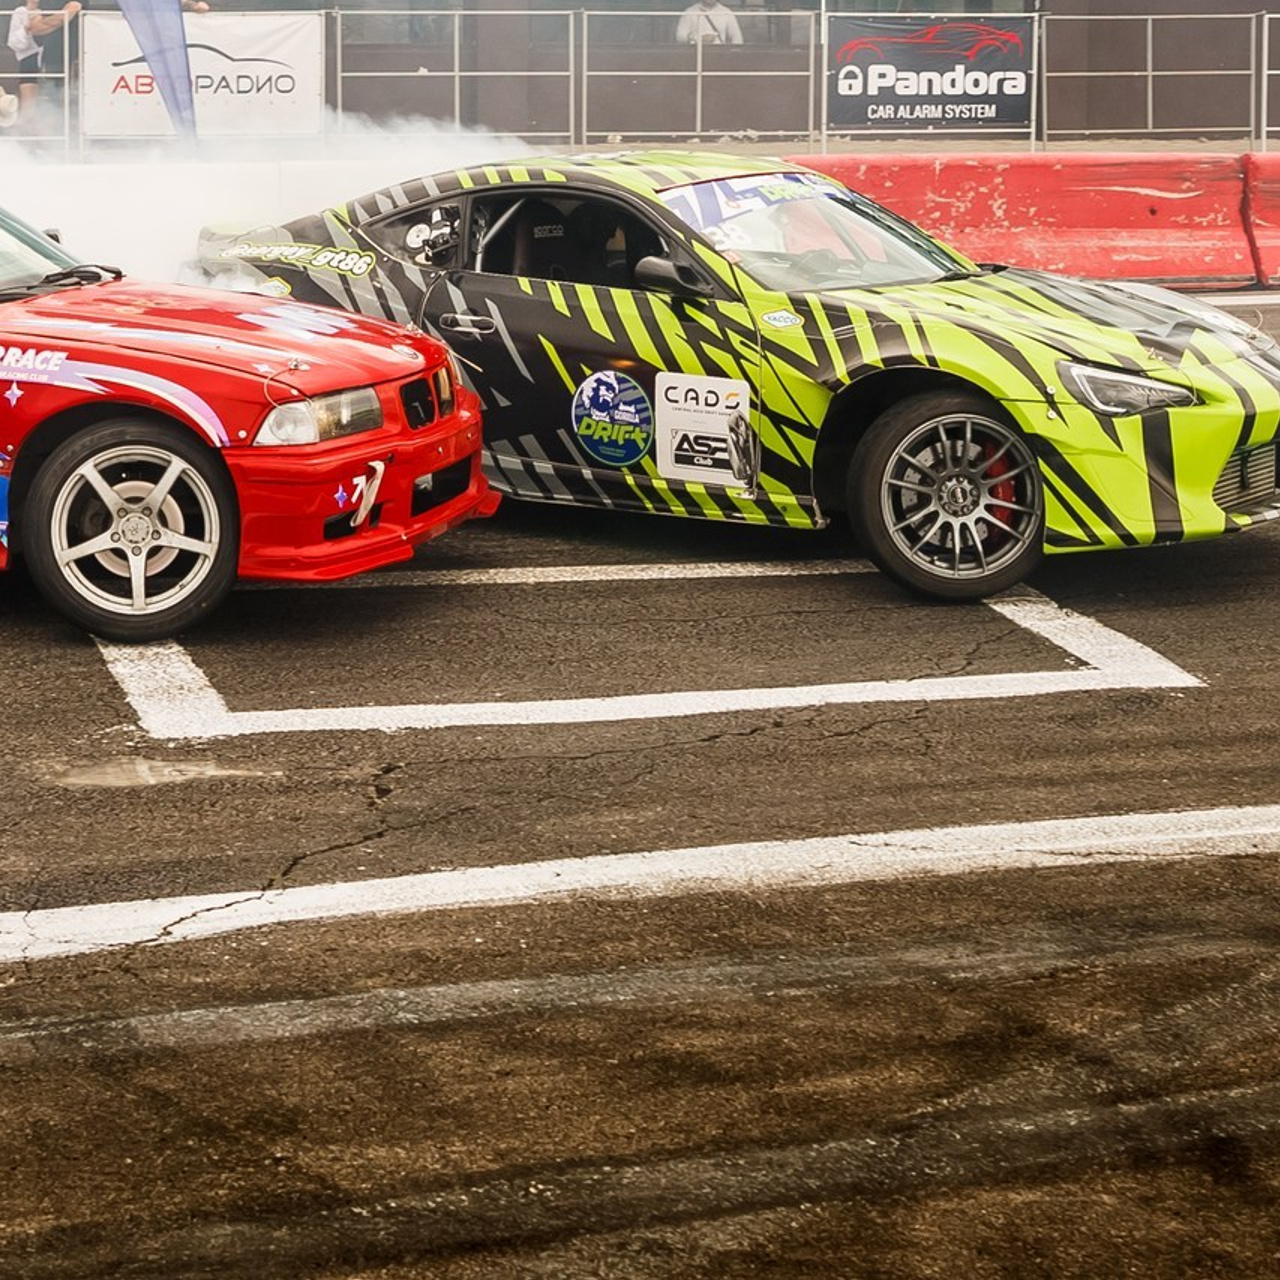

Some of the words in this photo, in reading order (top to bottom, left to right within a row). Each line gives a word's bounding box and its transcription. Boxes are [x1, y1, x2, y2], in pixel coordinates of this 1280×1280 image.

[866, 64, 1027, 96] Pandora
[867, 104, 895, 119] CAR
[896, 104, 943, 119] ALARM
[944, 104, 997, 119] SYSTEM
[664, 385, 741, 410] CADS
[578, 416, 648, 450] DRIFT
[693, 456, 714, 466] Club
